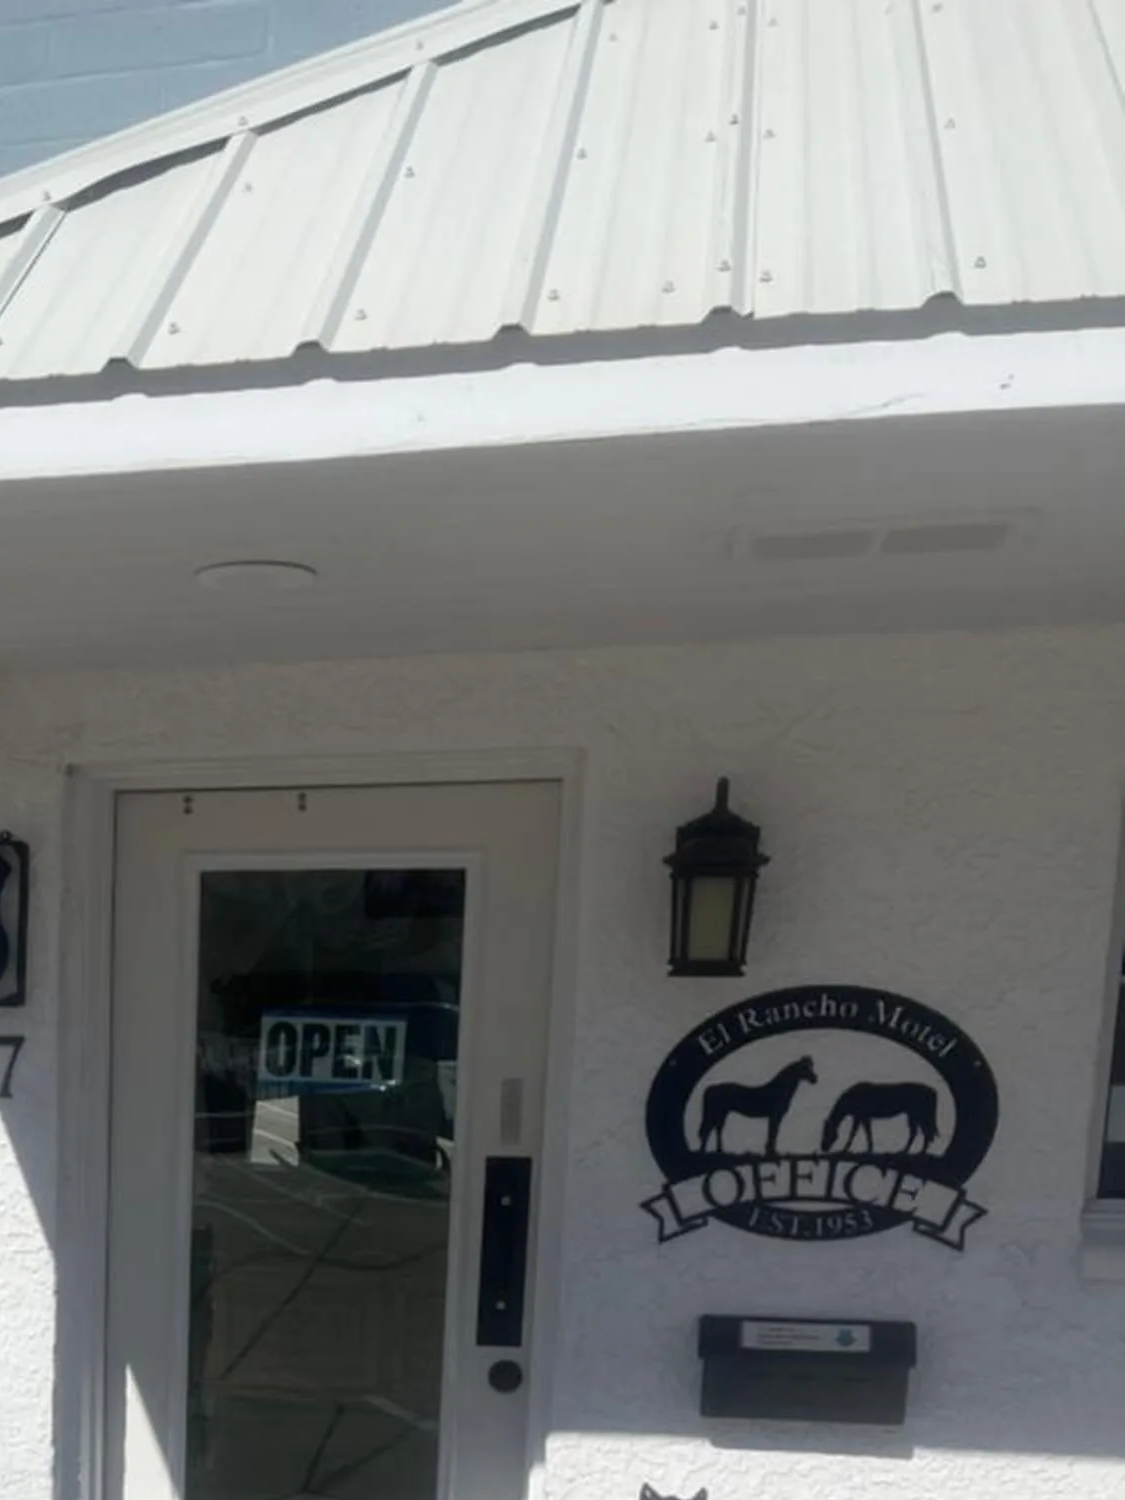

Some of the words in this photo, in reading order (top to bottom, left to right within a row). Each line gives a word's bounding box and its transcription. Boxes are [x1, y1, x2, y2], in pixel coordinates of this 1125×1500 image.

[265, 1020, 397, 1081] OPEN
[697, 1022, 731, 1056] El
[738, 994, 859, 1034] Rancho
[868, 999, 958, 1058] Motel
[702, 1158, 927, 1213] OFFICE
